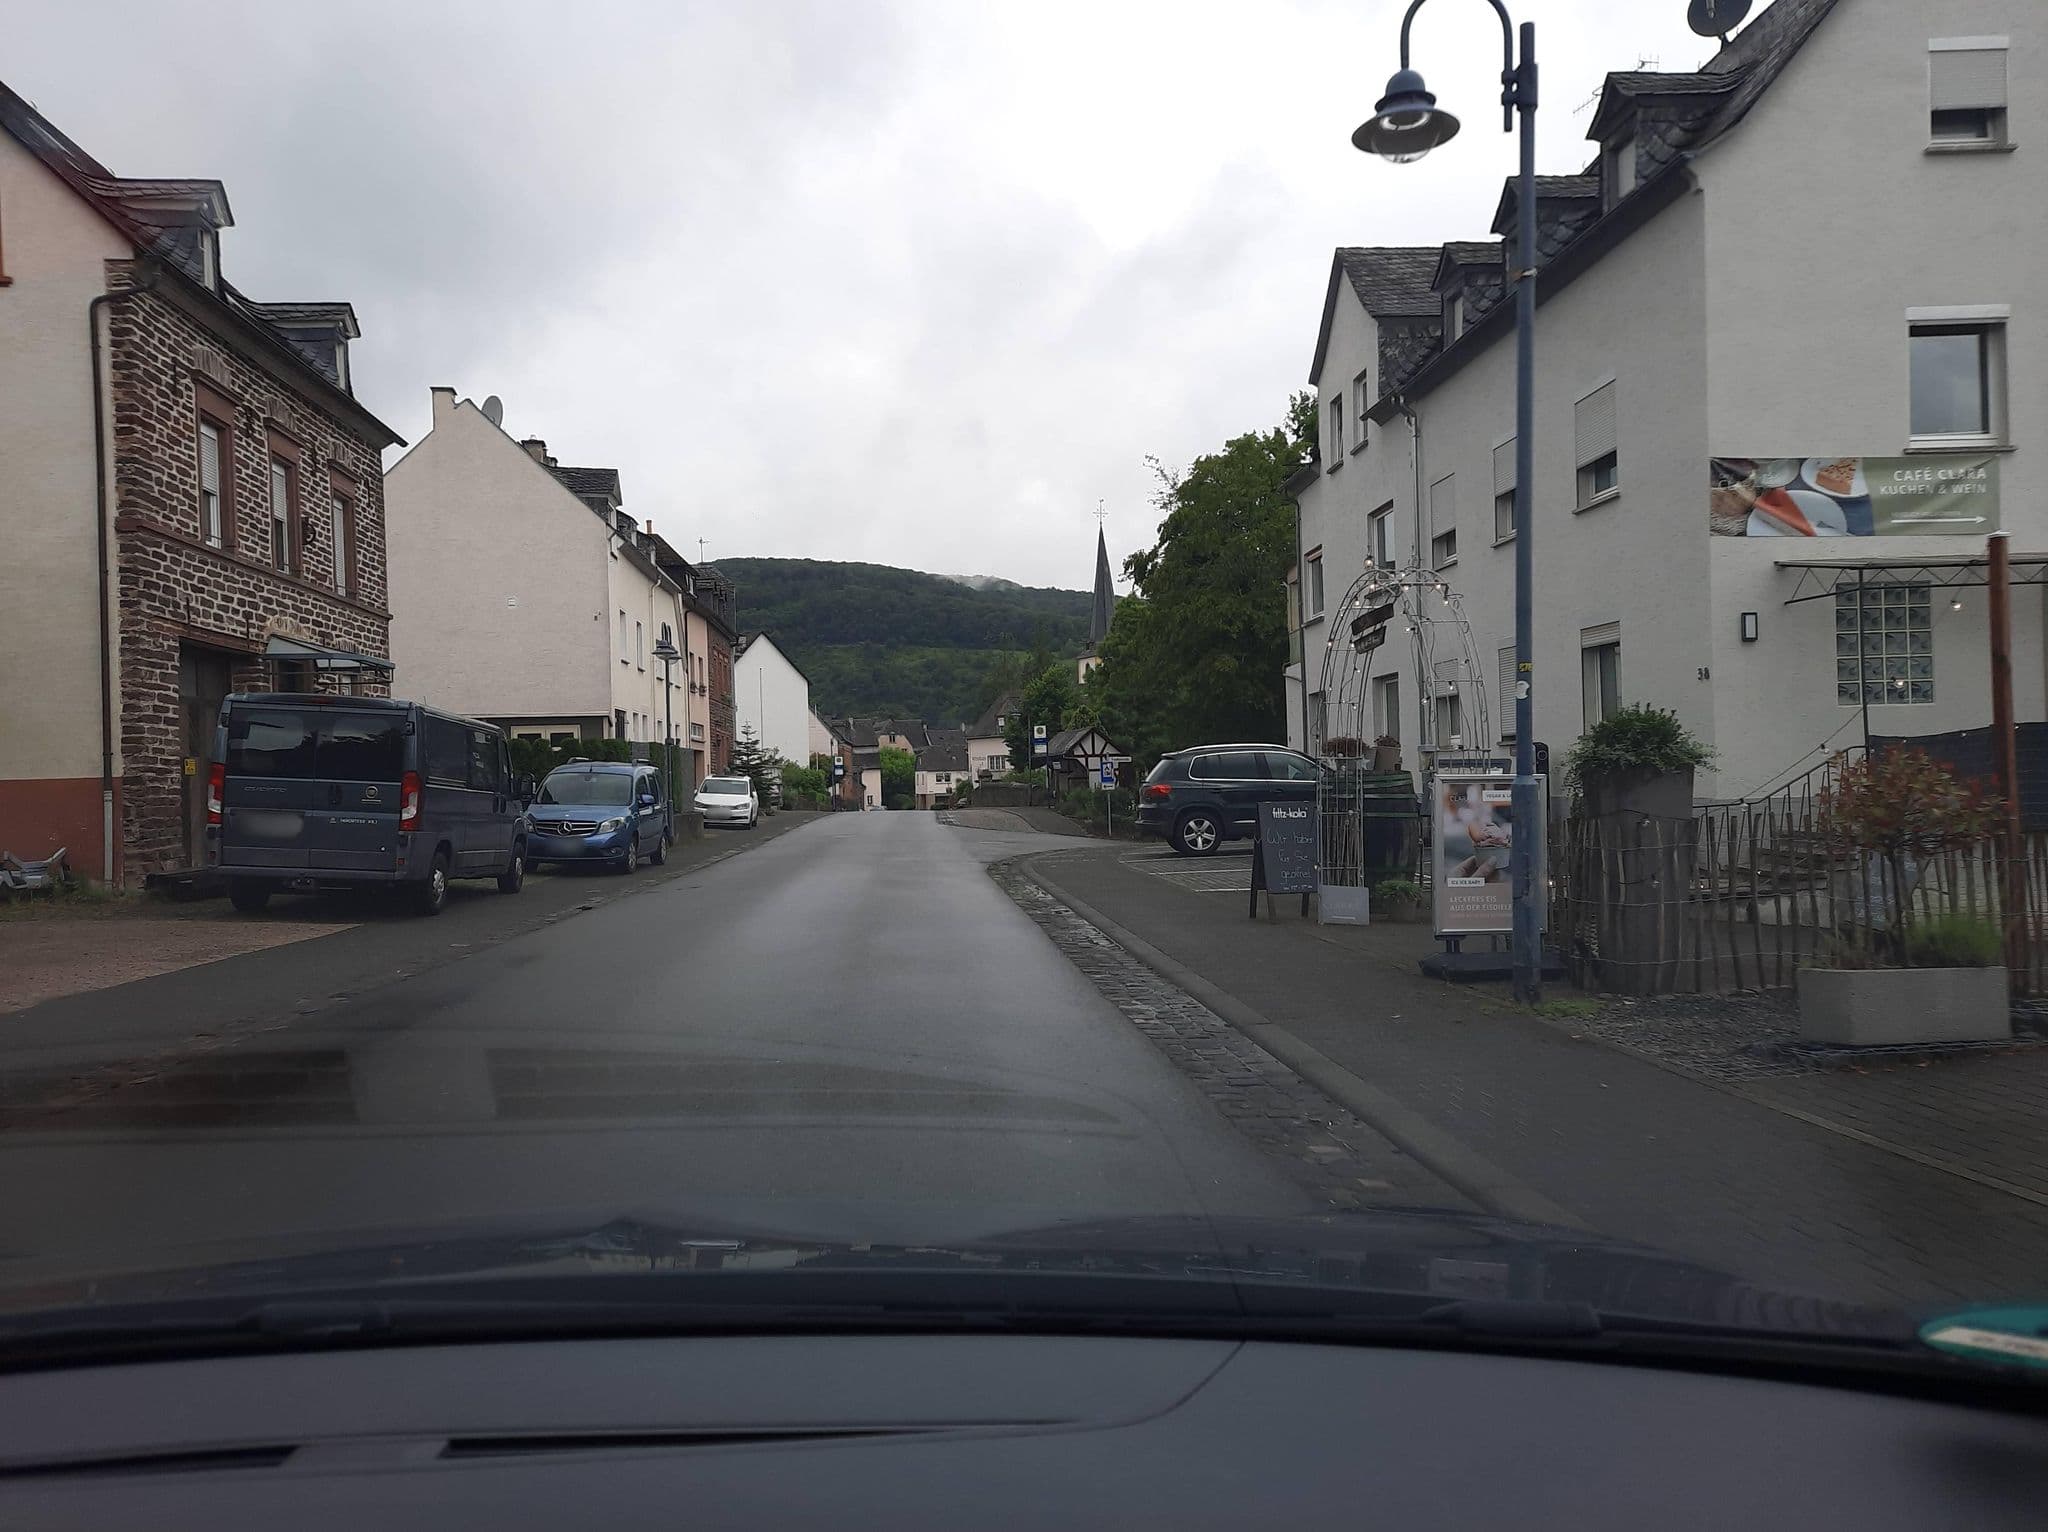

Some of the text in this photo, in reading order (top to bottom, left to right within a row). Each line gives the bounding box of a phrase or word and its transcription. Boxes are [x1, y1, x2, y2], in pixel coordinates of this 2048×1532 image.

[1893, 466, 1987, 482] CAFÉ CLARA
[1879, 483, 1987, 496] KUCHEN & WEIN
[1697, 667, 1711, 680] 38
[1272, 807, 1307, 819] fritz-kola
[1449, 895, 1497, 903] LECKERES EIS
[1449, 903, 1465, 911] AUS
[1466, 903, 1481, 911] DER
